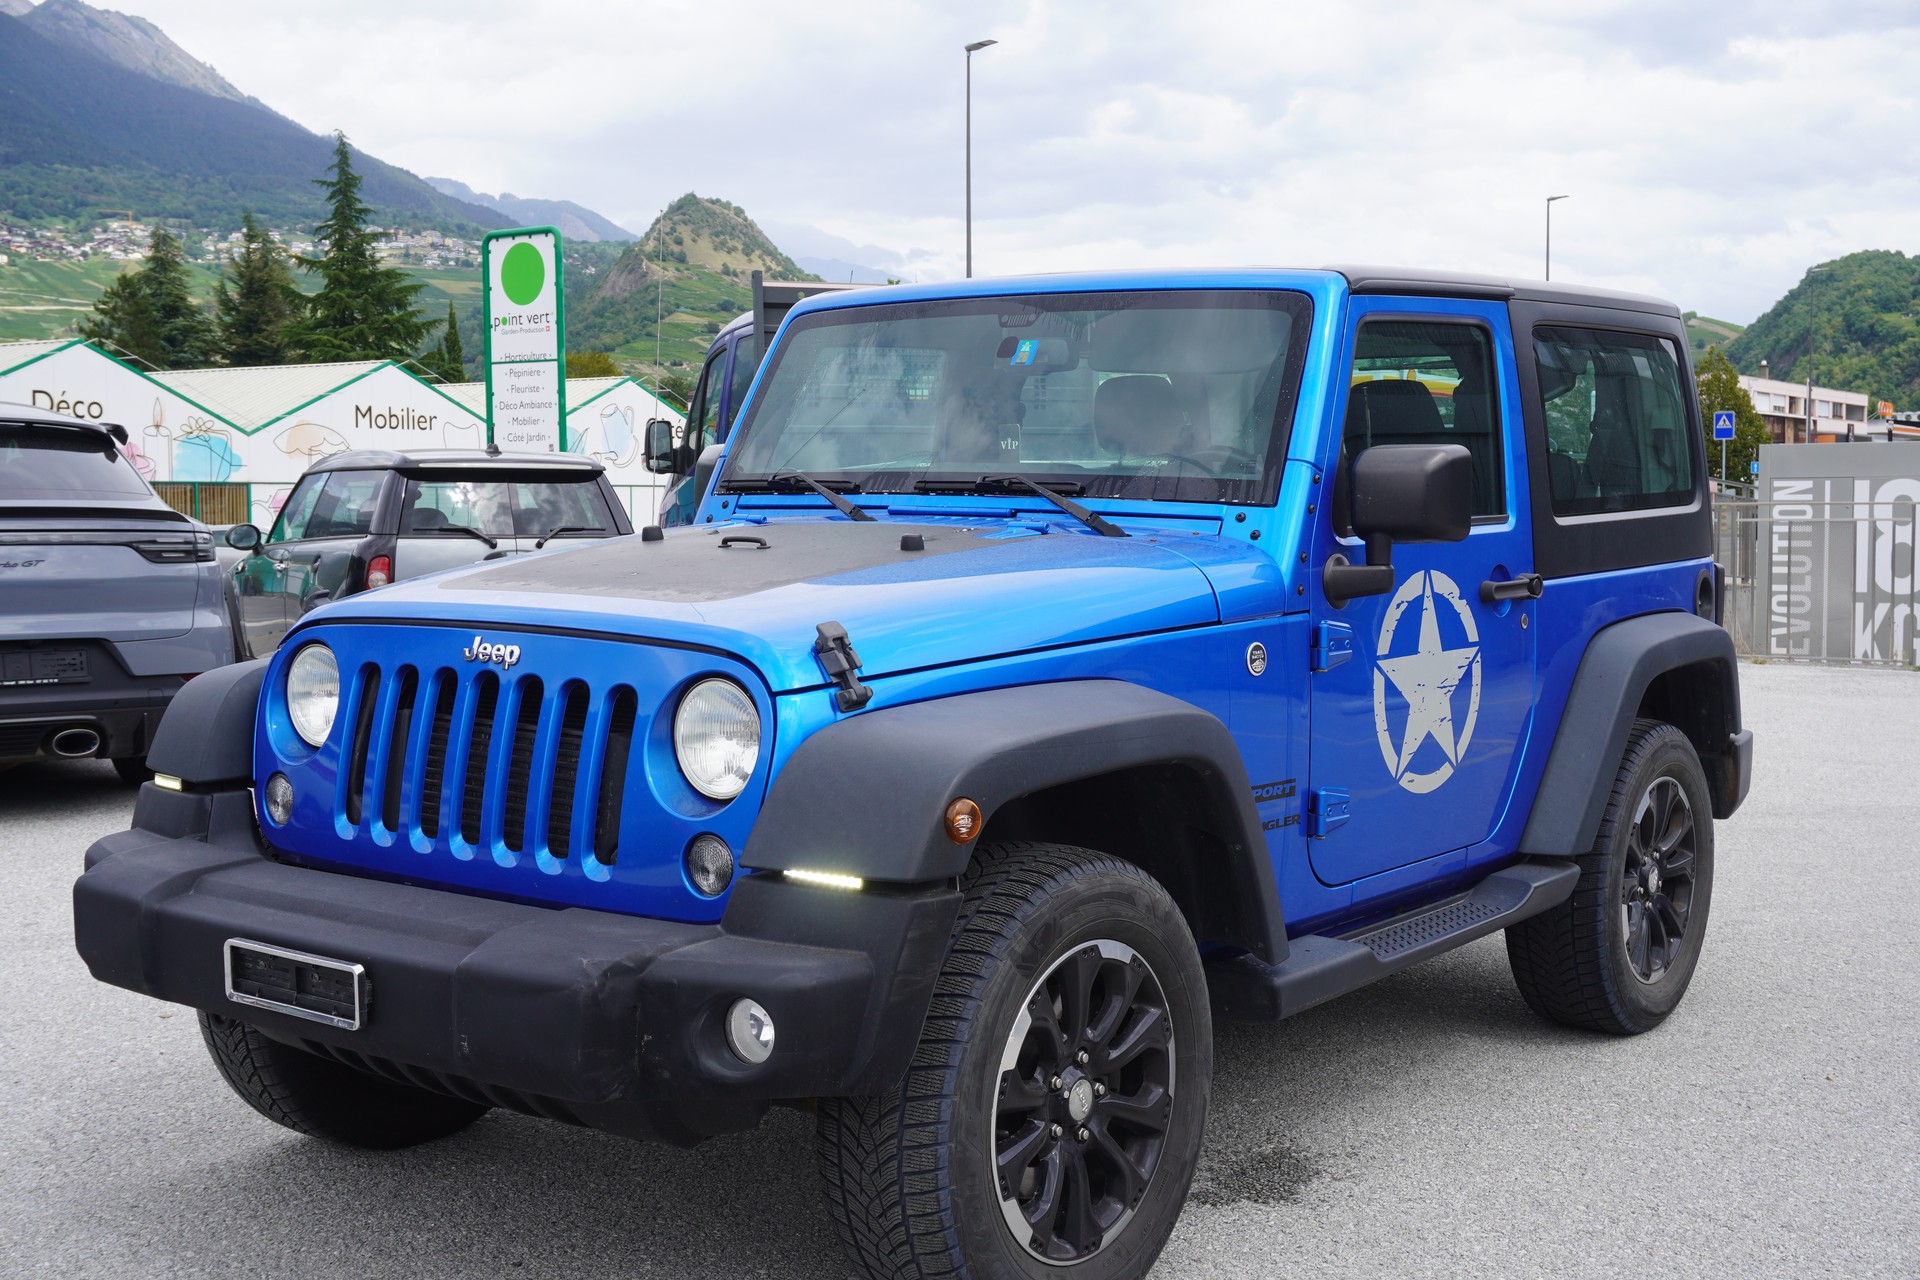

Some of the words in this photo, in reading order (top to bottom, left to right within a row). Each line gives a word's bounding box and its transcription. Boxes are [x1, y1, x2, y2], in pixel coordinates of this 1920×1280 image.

[493, 312, 523, 332] point
[526, 312, 550, 324] vert
[501, 327, 545, 335] Garden-Production
[504, 351, 547, 361] Horticulture
[509, 367, 541, 379] Pépinière
[510, 383, 540, 394] Fleuriste
[32, 390, 103, 419] Déco
[499, 401, 518, 411] Déco
[519, 399, 553, 410] Ambiance
[355, 404, 437, 431] Mobilier
[511, 416, 540, 426] Mobilier
[507, 431, 525, 443] Côté
[526, 432, 546, 444] Jardin
[463, 636, 521, 670] Jeep
[1251, 782, 1296, 798] PORT
